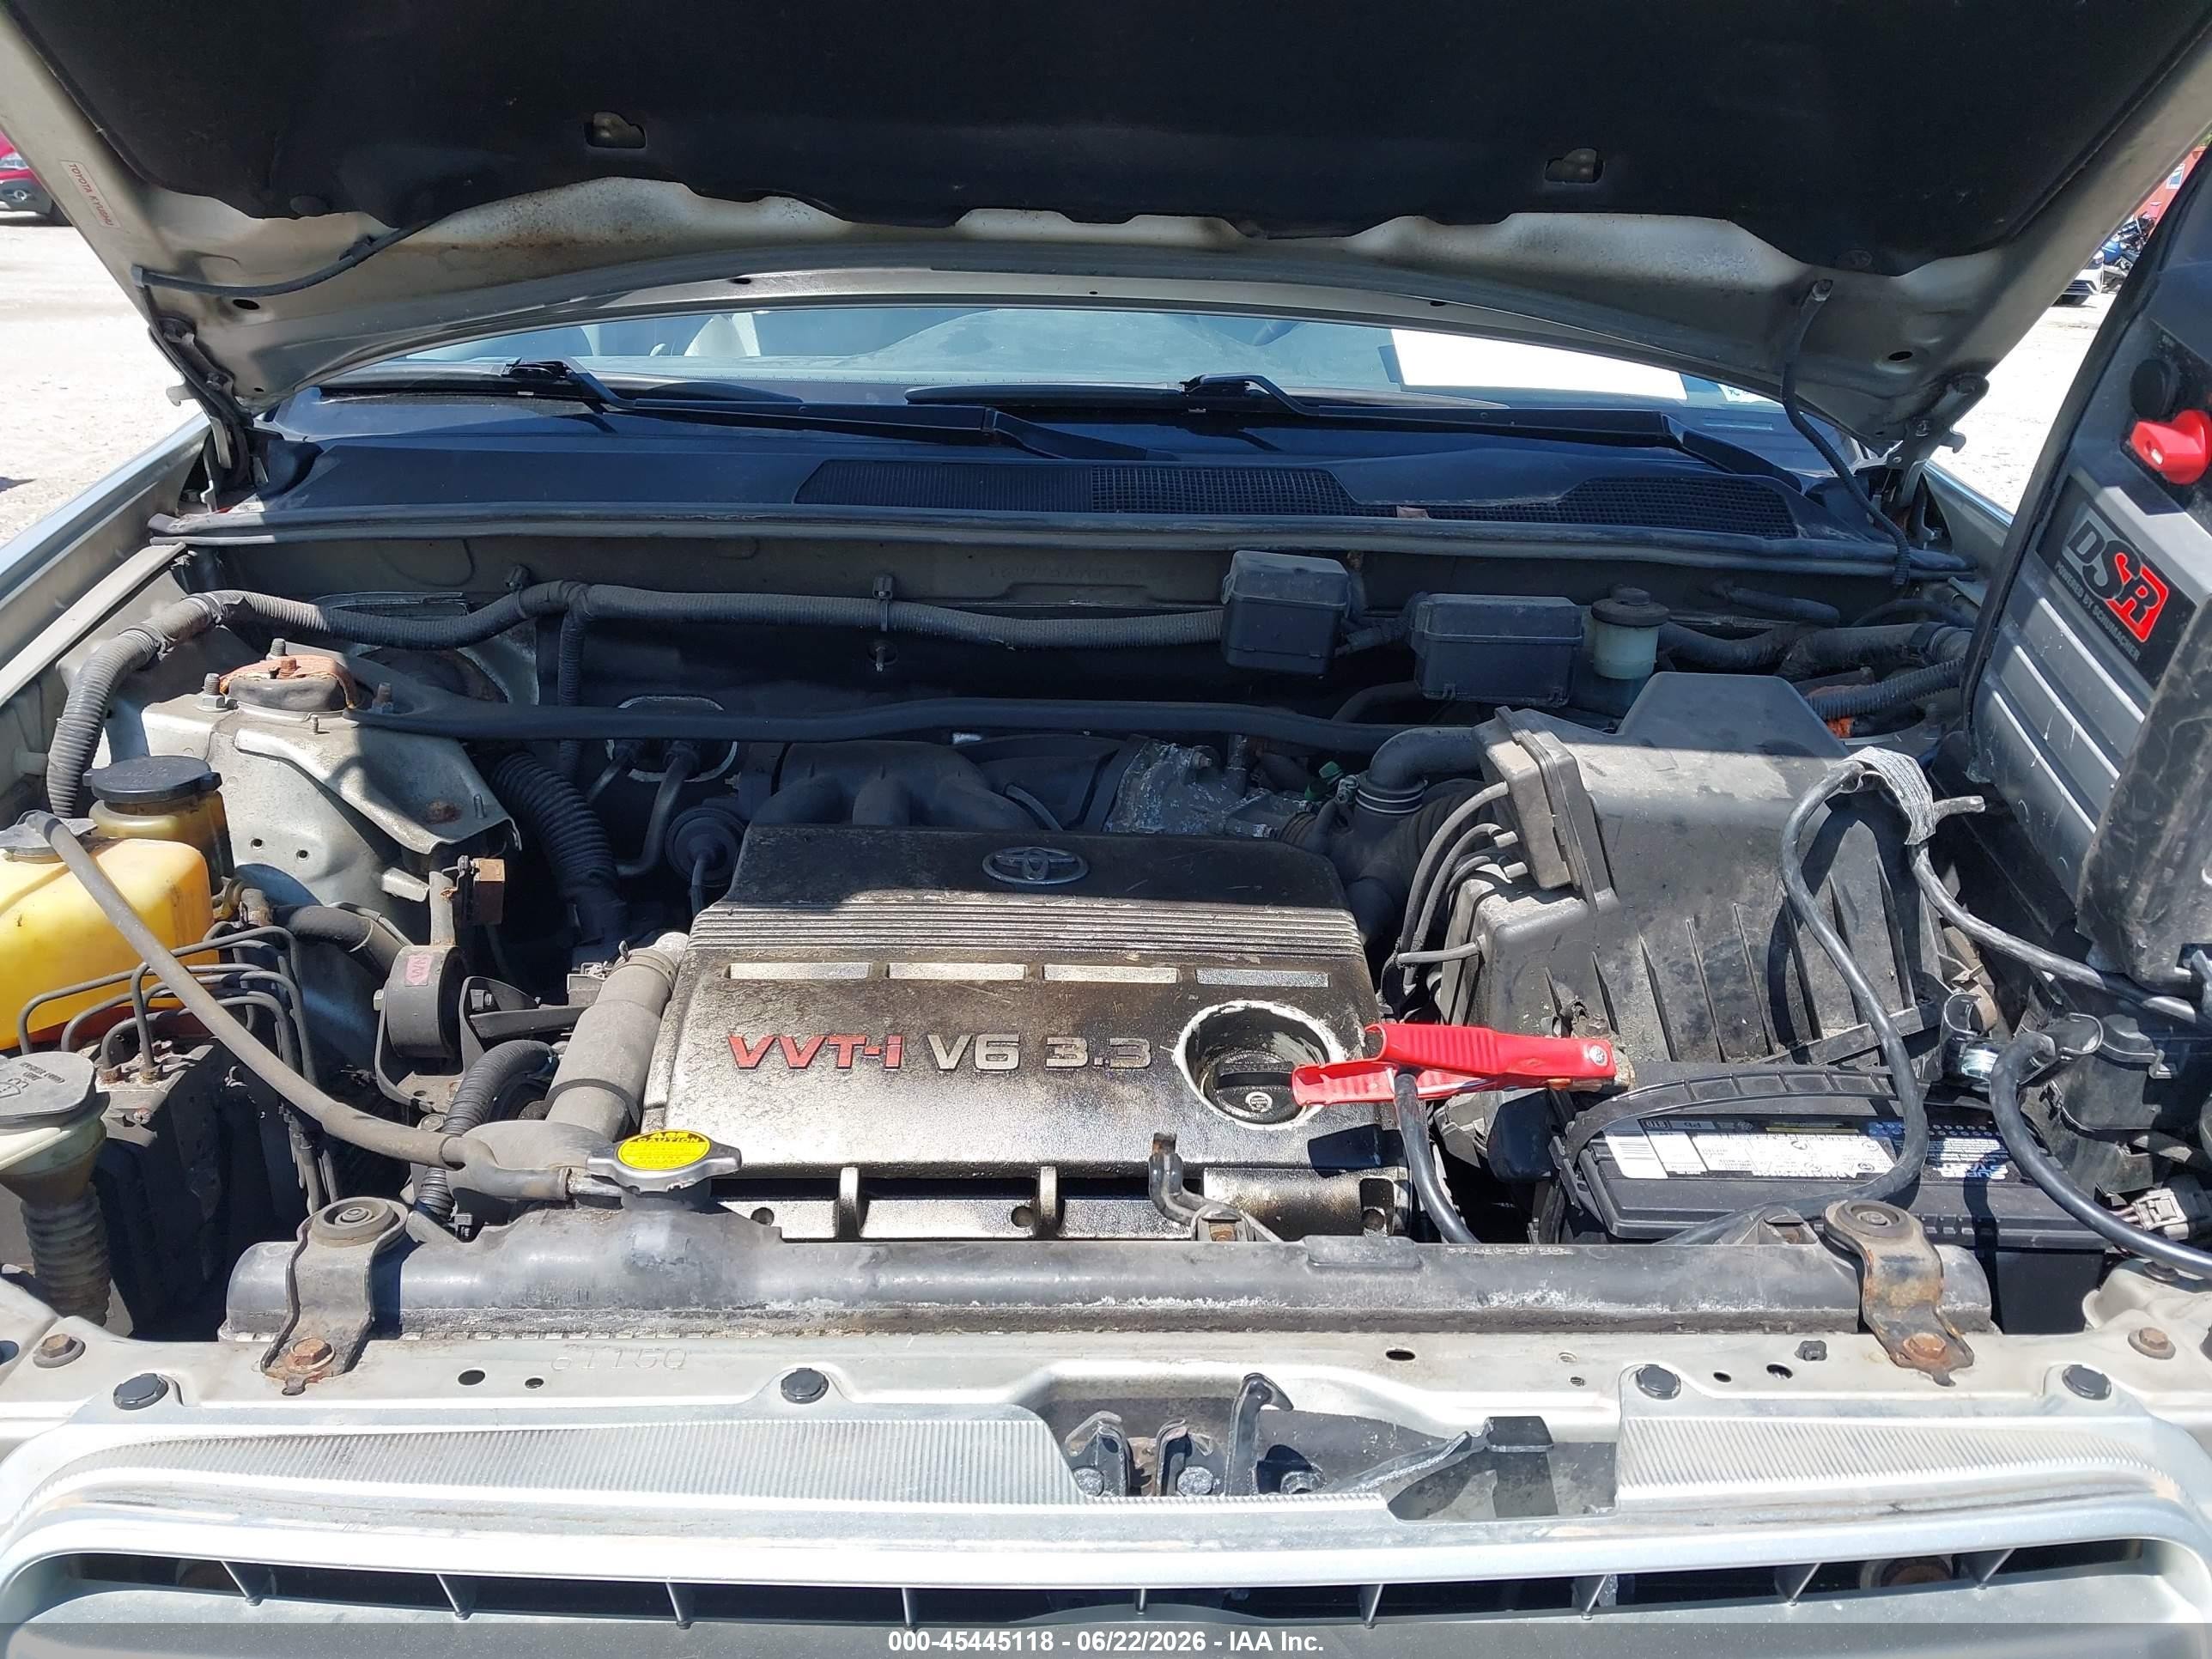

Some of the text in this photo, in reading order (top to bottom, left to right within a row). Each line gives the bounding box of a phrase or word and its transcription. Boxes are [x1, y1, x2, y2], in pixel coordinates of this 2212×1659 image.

[69, 163, 114, 226] TOYOTA KYUSHU
[2054, 560, 2142, 662] POWERED BY SCHUMACHER
[2068, 517, 2160, 626] DSR
[927, 1033, 1020, 1072] V6
[1045, 1036, 1152, 1070] 3.3
